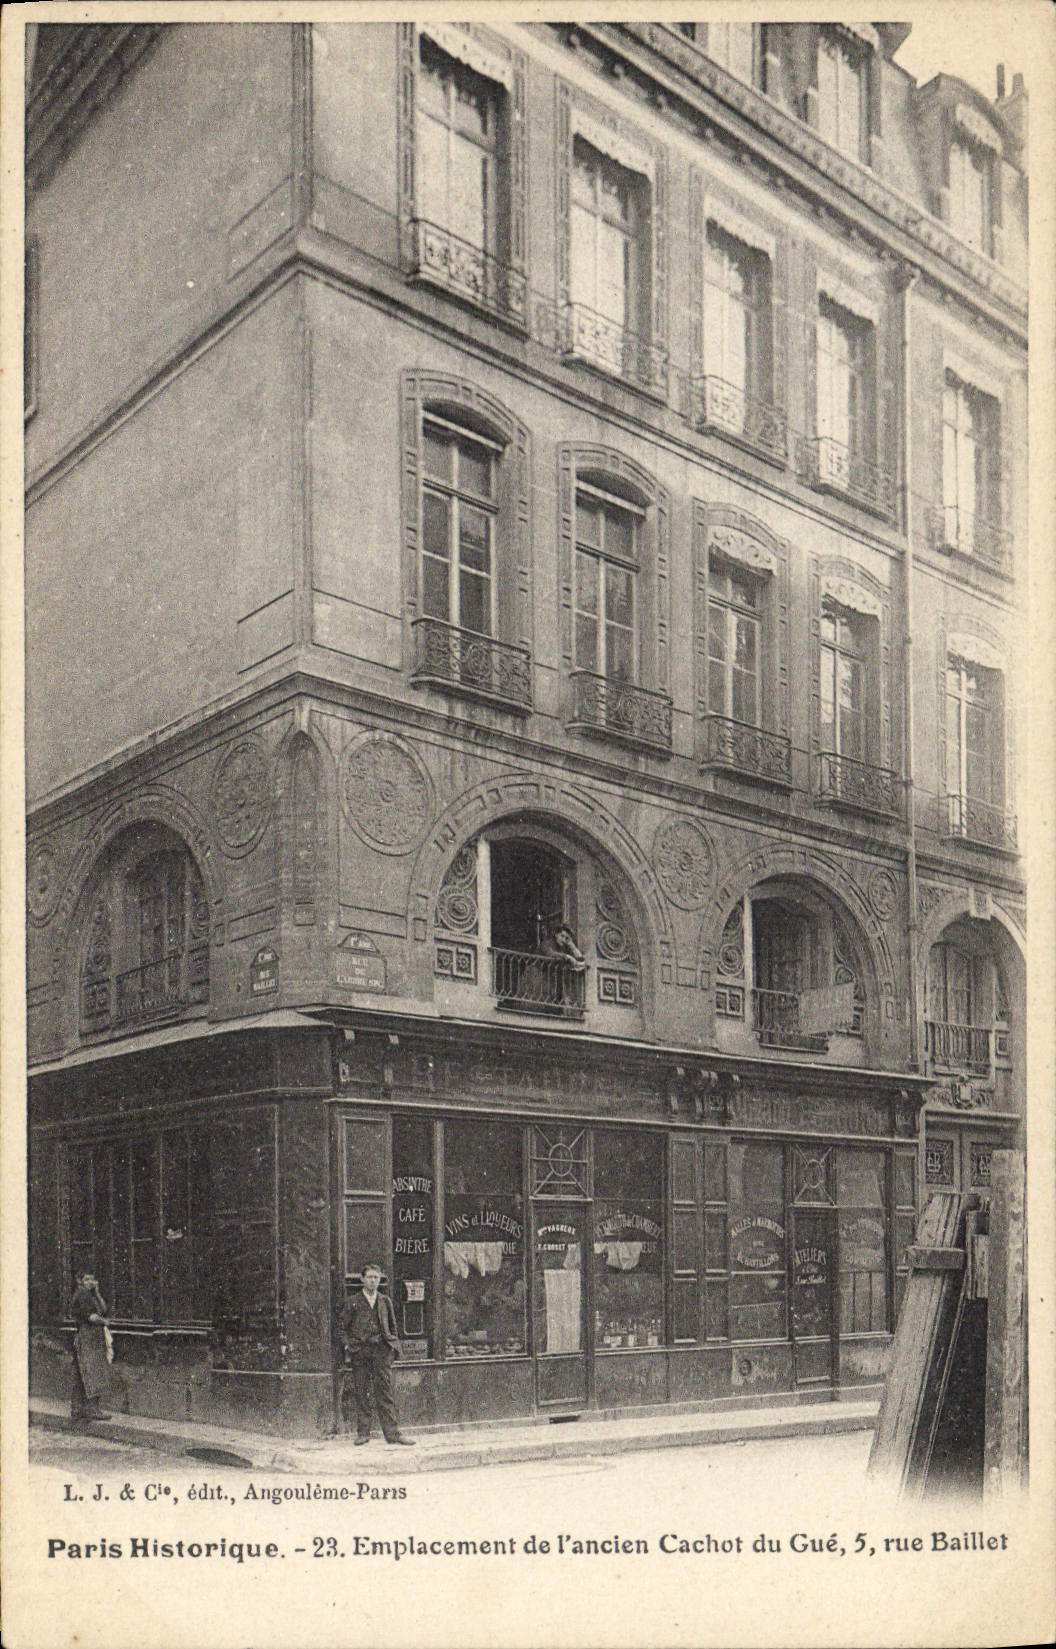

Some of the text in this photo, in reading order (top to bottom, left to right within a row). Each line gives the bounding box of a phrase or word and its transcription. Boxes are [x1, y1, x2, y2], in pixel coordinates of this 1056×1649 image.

[392, 1176, 432, 1193] ABSINTHE
[399, 1205, 426, 1223] CAFÉ
[445, 1213, 470, 1236] VINS
[480, 1210, 524, 1240] LIQUEURS
[794, 1247, 827, 1267] ATELIERS
